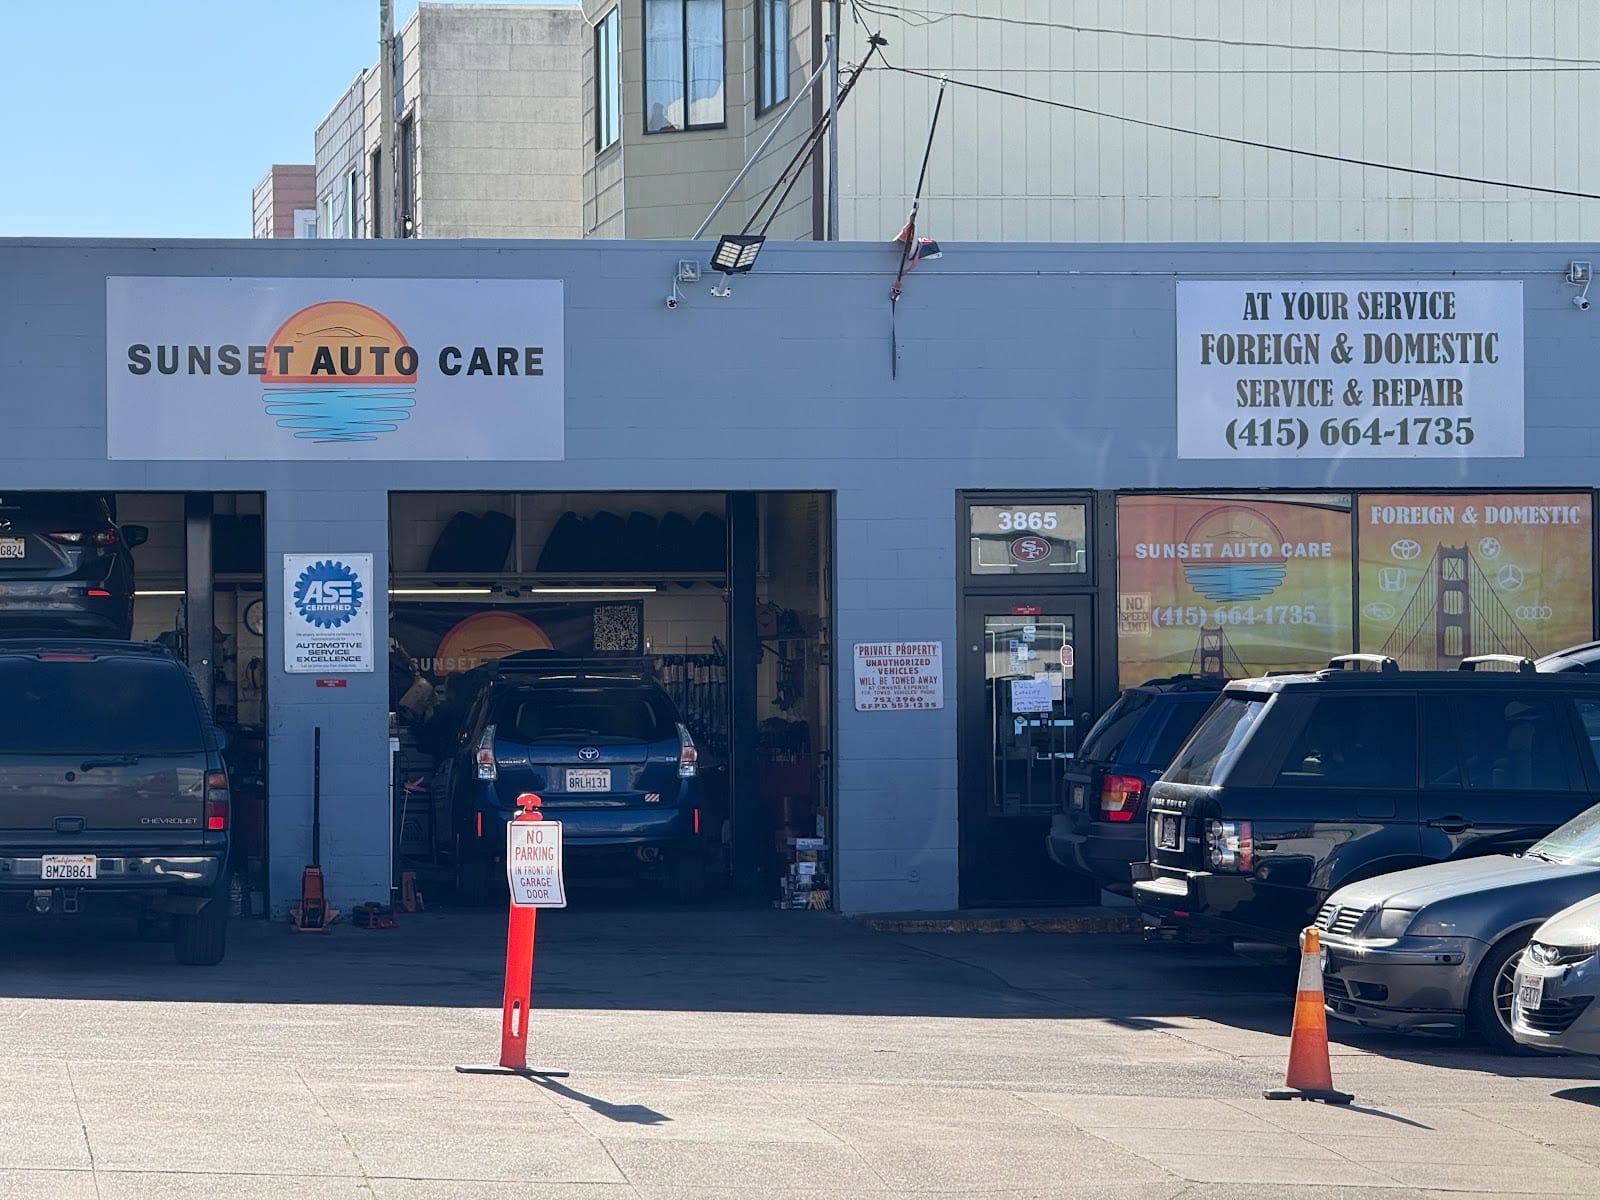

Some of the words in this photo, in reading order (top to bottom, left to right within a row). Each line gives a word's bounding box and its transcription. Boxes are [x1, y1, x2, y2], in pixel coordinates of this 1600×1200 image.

[1243, 292, 1272, 321] AT
[1281, 292, 1349, 320] YOUR
[1358, 291, 1456, 320] SERVICE
[1200, 334, 1320, 365] FOREIGN
[1331, 332, 1354, 364] &
[1363, 332, 1499, 364] DOMESTIC
[127, 344, 294, 375] SUNSET
[310, 345, 419, 375] AUTO
[438, 346, 544, 376] CARE
[1236, 379, 1334, 407] SERVICE
[1342, 378, 1363, 407] &
[1372, 378, 1464, 407] REPAIR
[1225, 418, 1309, 450] (415)
[1320, 417, 1475, 446] 664-1735
[998, 512, 1057, 530] 3865
[1370, 506, 1455, 524] FOREIGN
[1462, 505, 1478, 524] &
[1484, 506, 1580, 524] DOMESTIC
[1135, 543, 1214, 559] SUNSET
[1221, 543, 1273, 558] AUTO
[1280, 542, 1332, 558] CARE
[302, 581, 352, 603] ASE
[1125, 597, 1143, 611] NO
[1121, 612, 1148, 621] SPEED
[1152, 606, 1207, 628] (415)
[1214, 605, 1317, 625] 664-1735
[1121, 622, 1148, 632] LIMIT
[859, 645, 892, 656] PRIVATE
[896, 644, 937, 655] PROPERTY
[409, 657, 479, 671] SUNSET
[865, 659, 931, 667] UNAUTHORIZED
[878, 667, 919, 675] VEHICLES
[859, 677, 876, 686] WILL
[880, 677, 888, 685] BE
[892, 676, 916, 685] TOWED
[918, 675, 938, 684] AWAY
[569, 777, 608, 788] 8RLH131
[526, 830, 544, 844] NO
[515, 847, 554, 861] PARKING
[46, 865, 93, 878] 8MZB861
[515, 866, 522, 875] IN
[524, 866, 544, 875] FRONT
[546, 865, 554, 875] OF
[520, 877, 552, 887] GARAGE
[526, 889, 549, 899] DOOR
